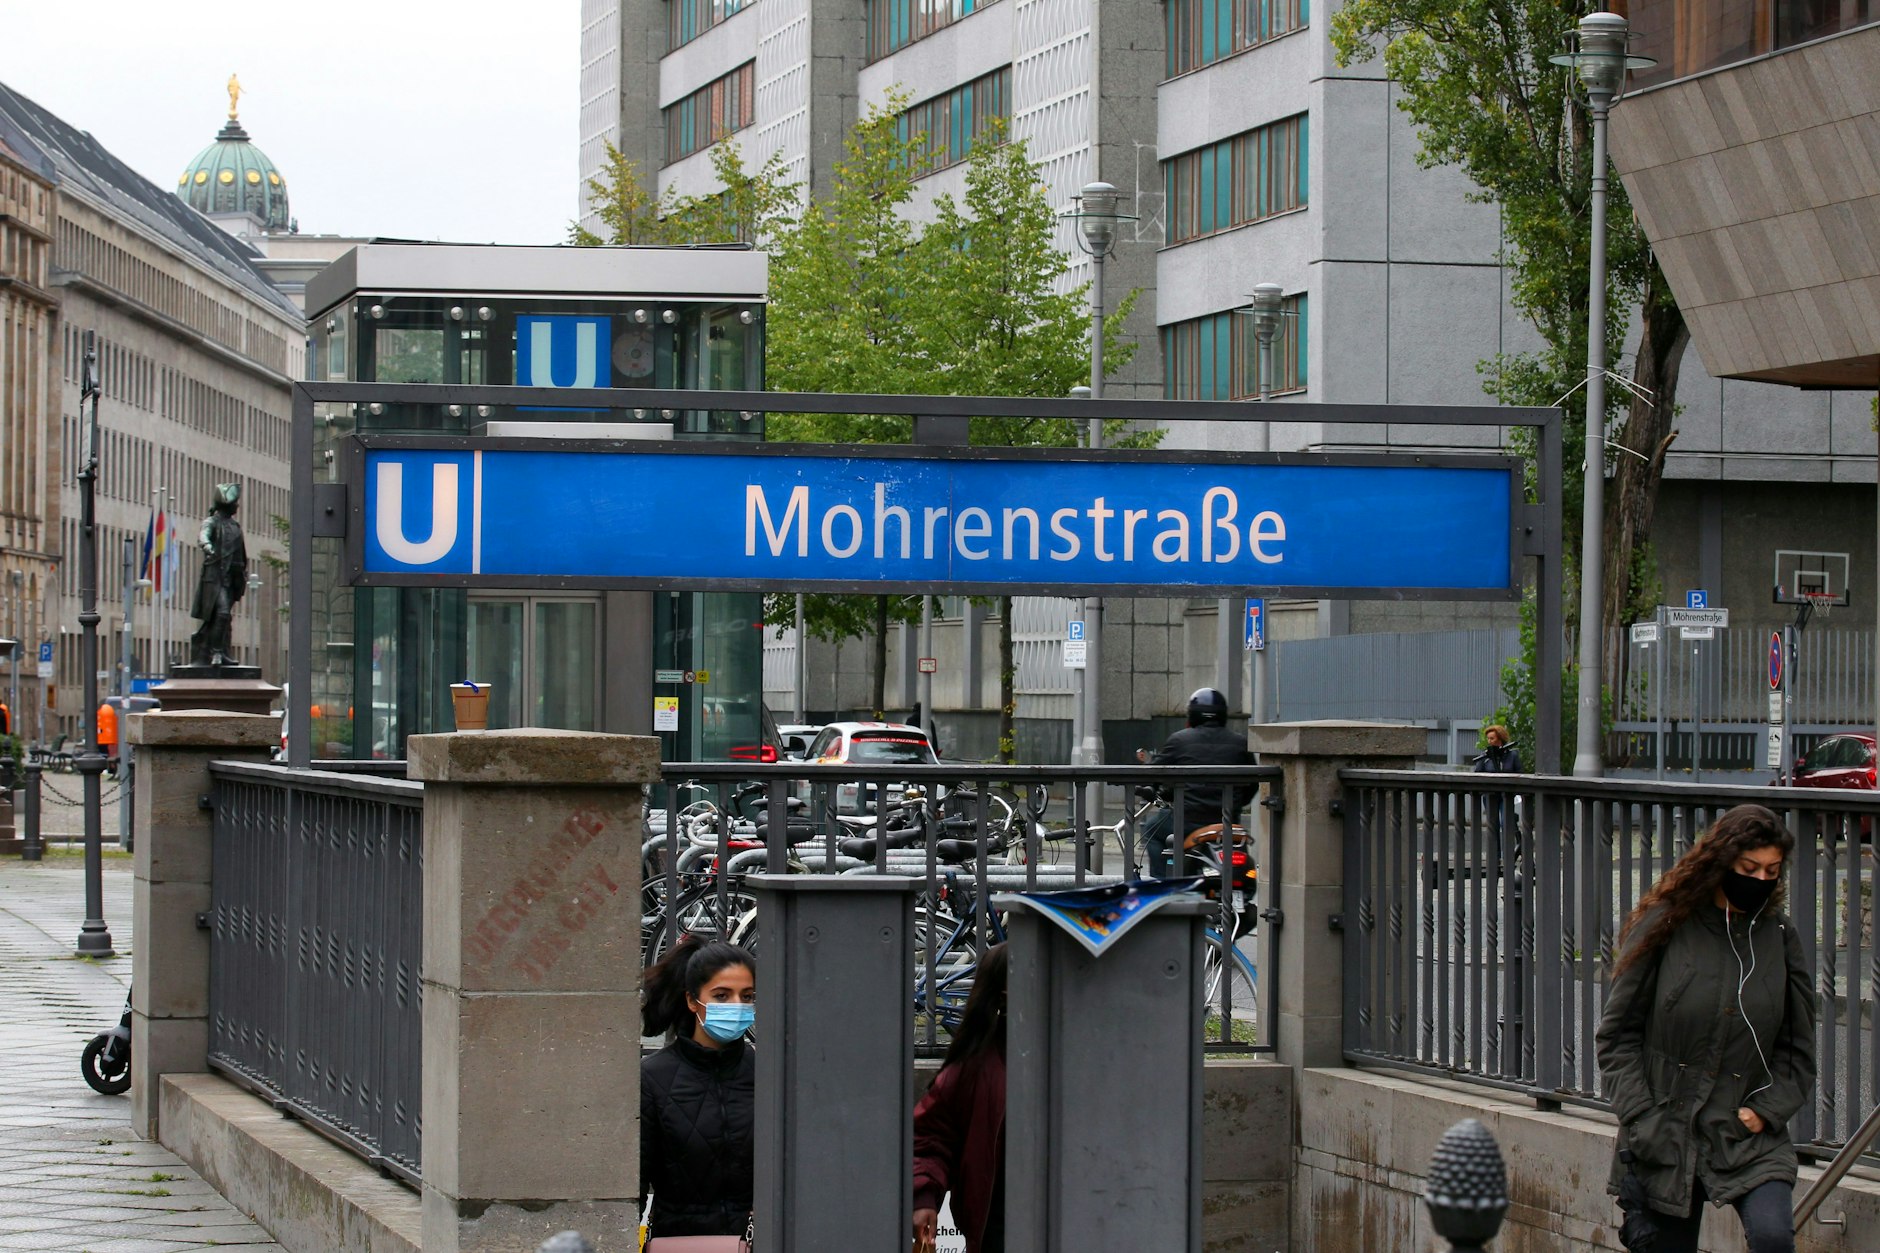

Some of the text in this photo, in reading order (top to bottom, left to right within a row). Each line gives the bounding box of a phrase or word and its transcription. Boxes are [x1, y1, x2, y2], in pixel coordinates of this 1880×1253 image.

[530, 321, 597, 388] U
[376, 461, 1287, 565] U Mohrenstraße
[1071, 623, 1081, 639] P
[1691, 593, 1703, 608] P
[557, 862, 620, 934] CITY
